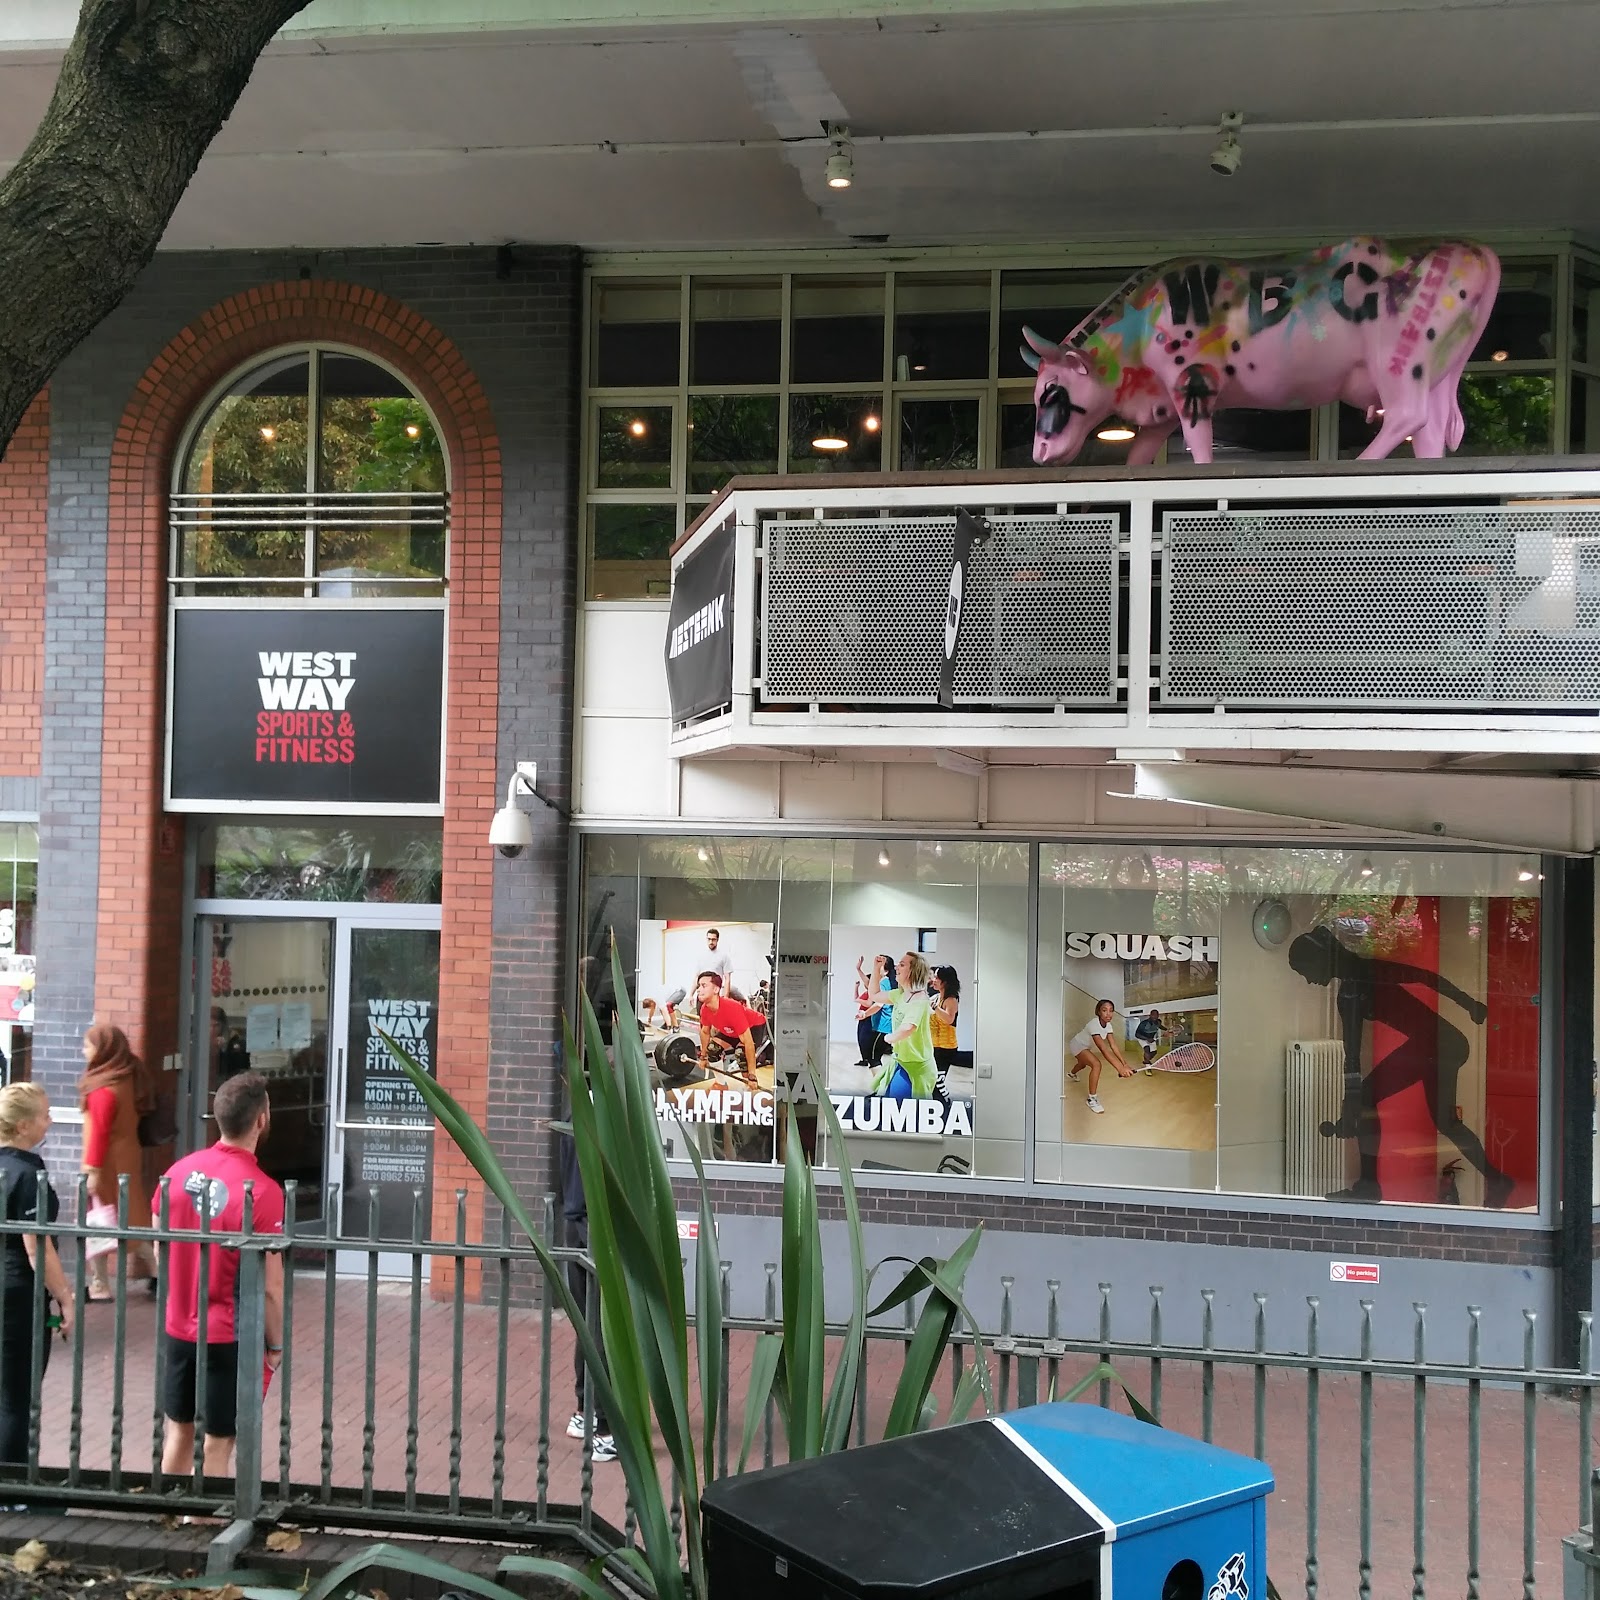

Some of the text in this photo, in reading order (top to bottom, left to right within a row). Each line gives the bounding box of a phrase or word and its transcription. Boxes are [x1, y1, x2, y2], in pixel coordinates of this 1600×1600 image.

[257, 651, 357, 677] WEST
[257, 677, 357, 711] WAY
[256, 711, 356, 738] SPORTS &
[255, 737, 356, 763] FITNESS
[1065, 932, 1219, 962] SQUASH
[368, 999, 431, 1016] WEST
[367, 1015, 431, 1038] WAY
[366, 1037, 430, 1056] SPTS &
[365, 1053, 430, 1072] FITNS
[365, 1081, 401, 1090] OPENING
[365, 1089, 393, 1102] MON
[409, 1090, 426, 1103] FR
[651, 1088, 774, 1114] LYMPIC
[656, 1103, 774, 1126] EIGHTLIFTING
[362, 1171, 379, 1181] 020
